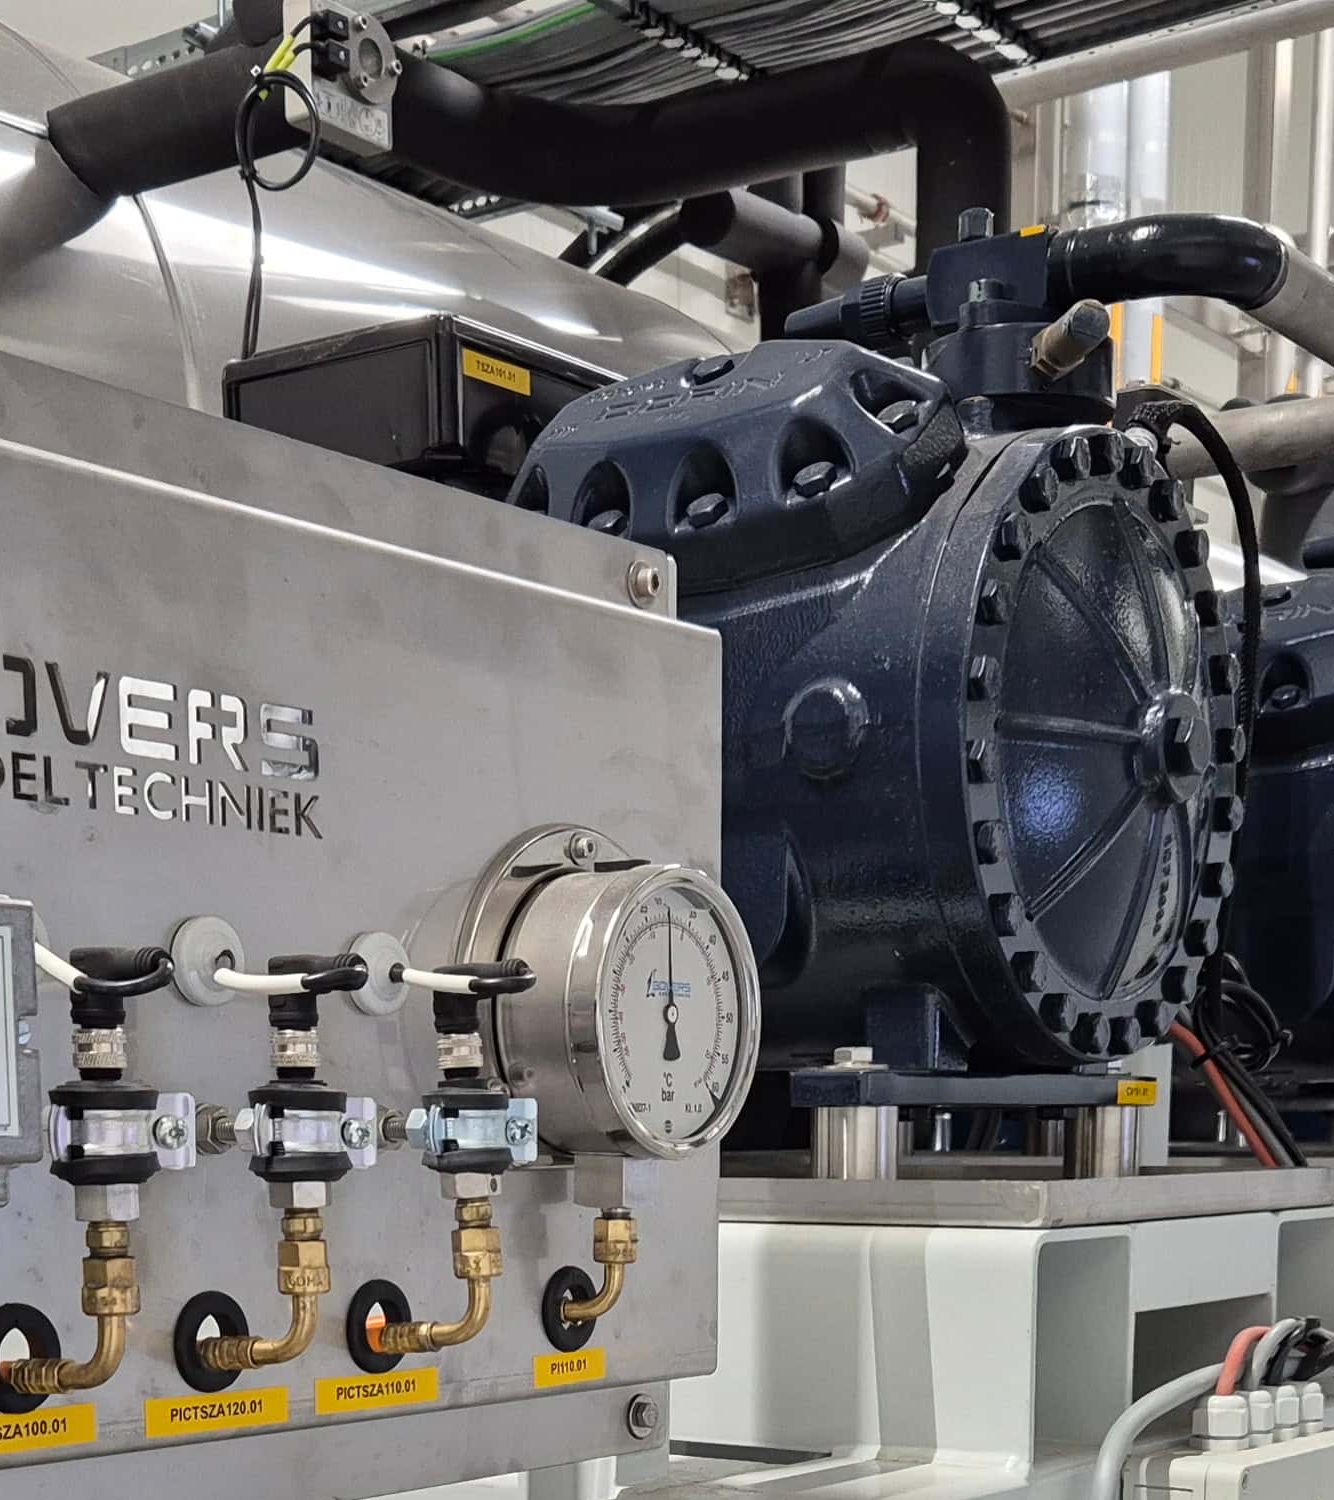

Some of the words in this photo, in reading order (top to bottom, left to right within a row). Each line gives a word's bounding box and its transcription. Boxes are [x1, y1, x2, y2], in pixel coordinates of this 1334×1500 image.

[661, 1087, 675, 1102] bar
[549, 1358, 588, 1377] PI110.01
[335, 1378, 418, 1402] PICTSZA110.01
[169, 1399, 265, 1424] PICTSZA120.01
